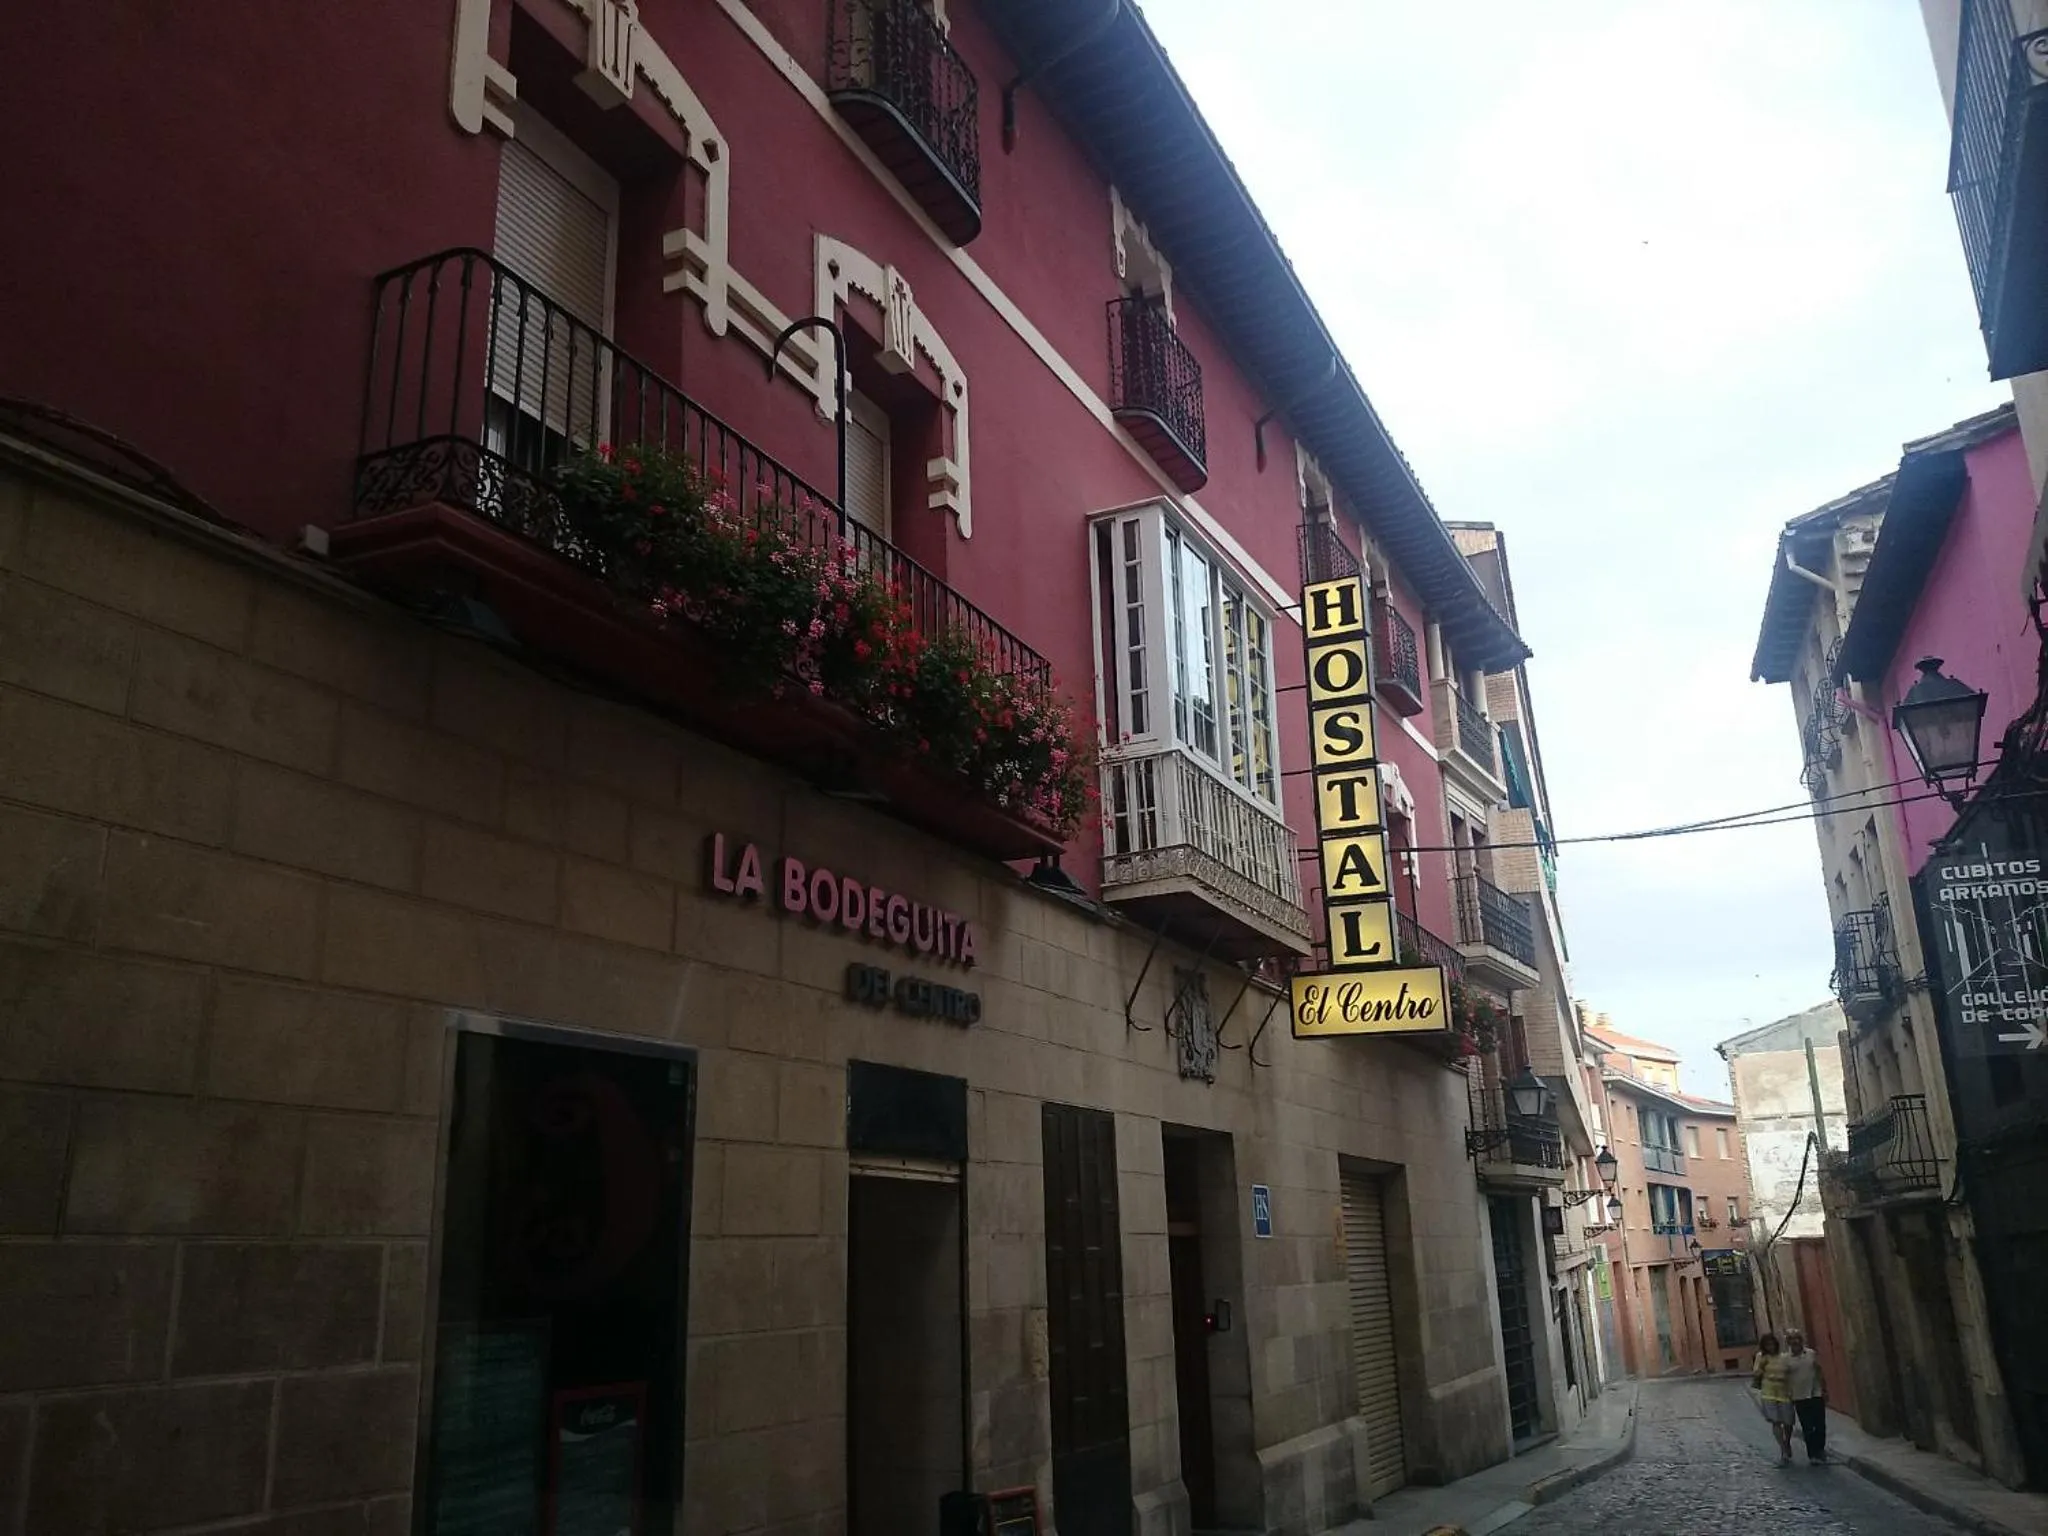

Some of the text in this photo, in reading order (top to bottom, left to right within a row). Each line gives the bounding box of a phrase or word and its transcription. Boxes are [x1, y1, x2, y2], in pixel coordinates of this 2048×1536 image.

[1311, 583, 1380, 957] HOSTAL
[1940, 881, 2048, 901] ARKANOS
[1941, 860, 2040, 880] CUBITOS
[713, 832, 978, 963] LA BODEGUITA
[1299, 982, 1439, 1026] El Centro
